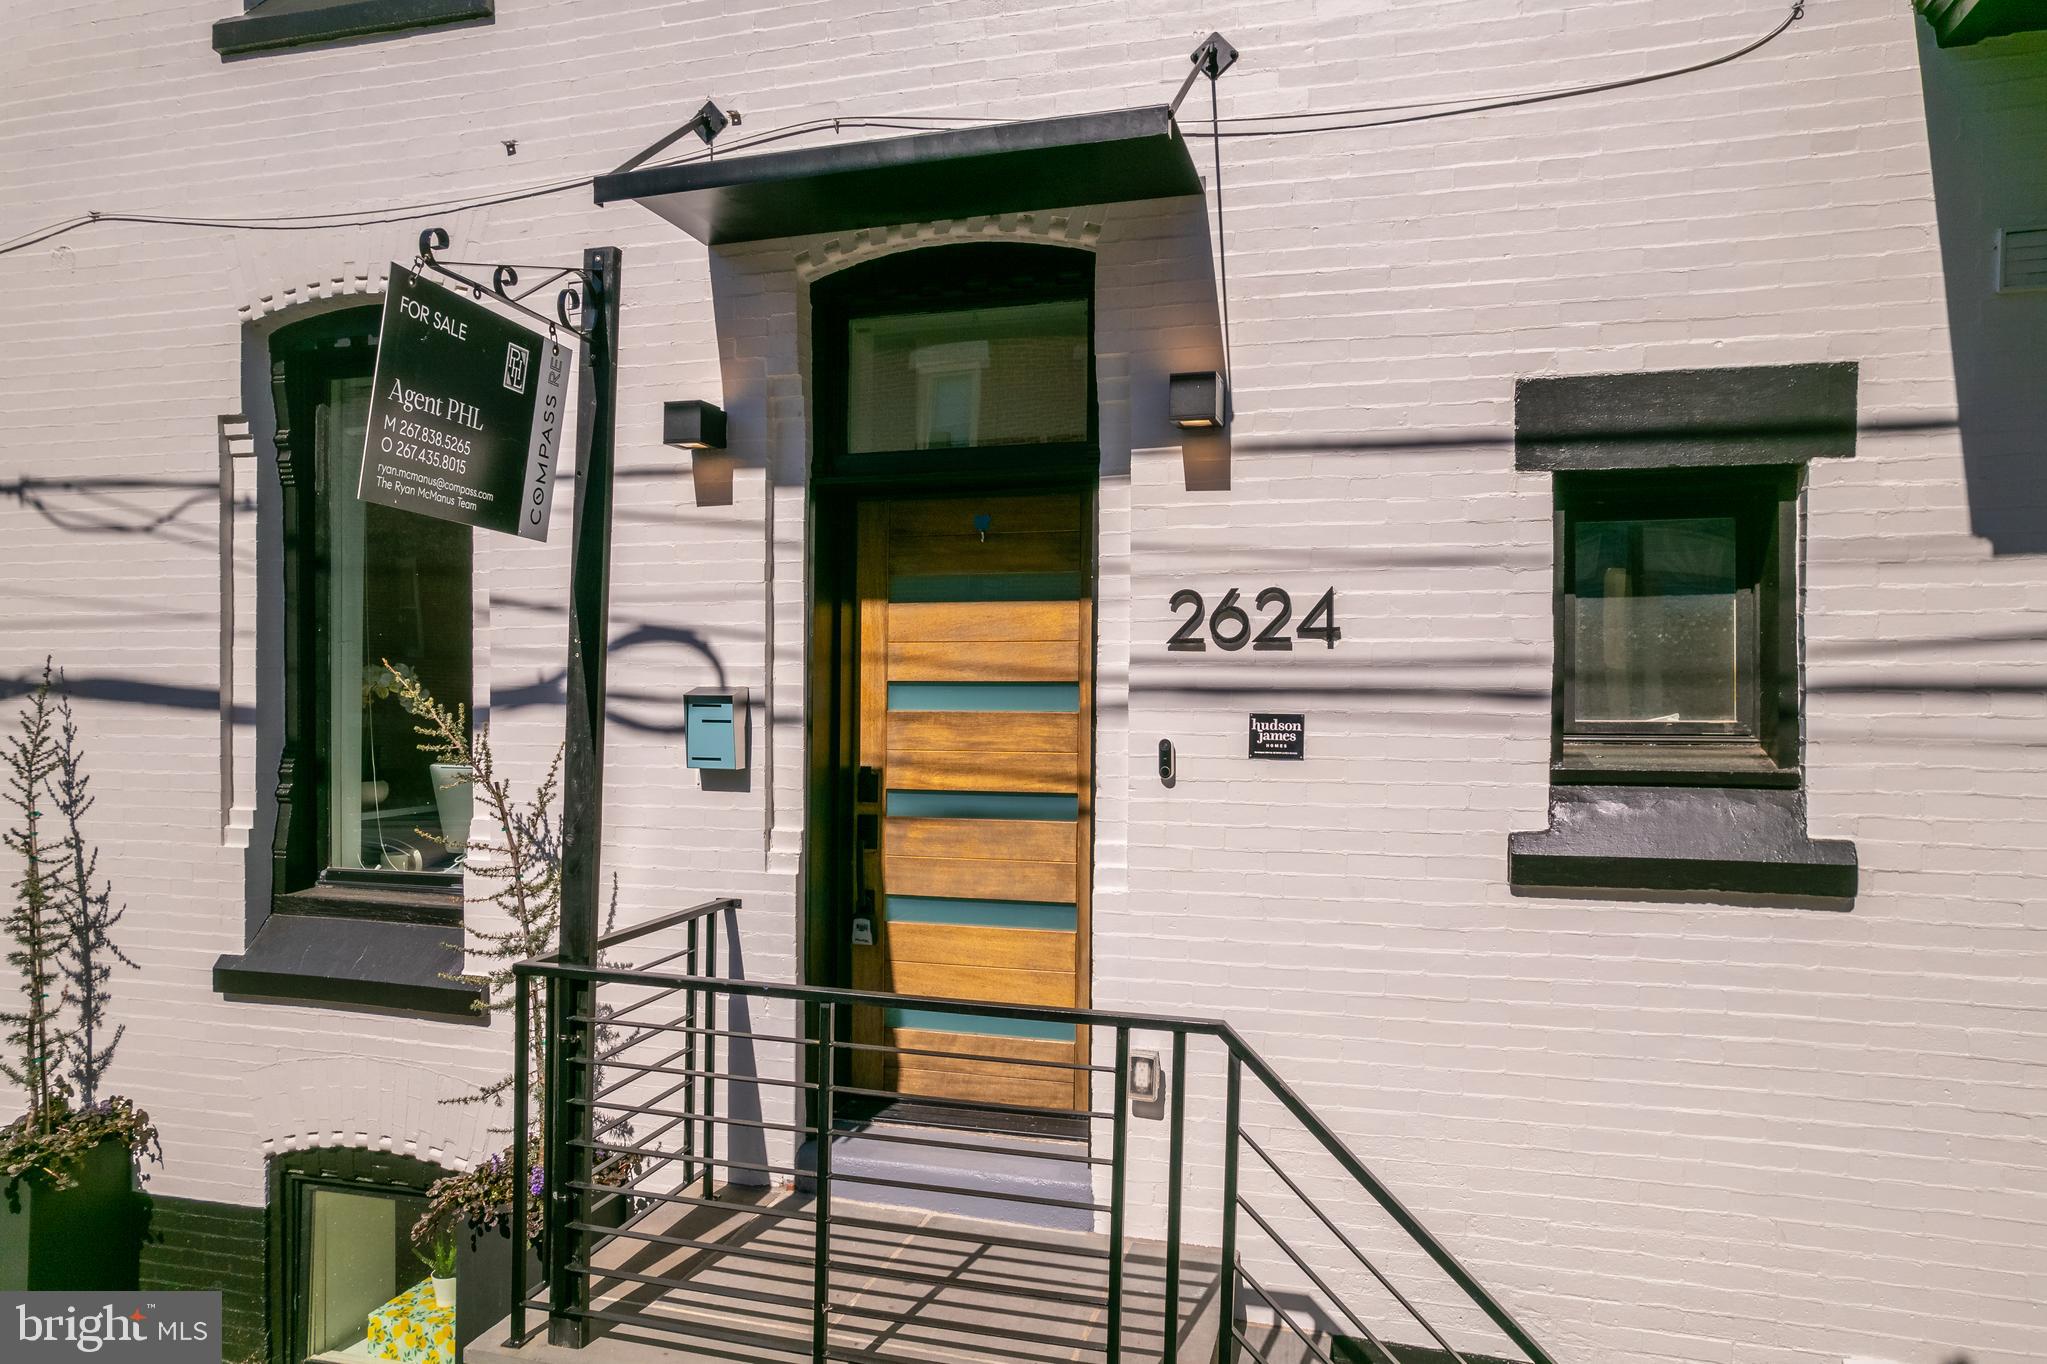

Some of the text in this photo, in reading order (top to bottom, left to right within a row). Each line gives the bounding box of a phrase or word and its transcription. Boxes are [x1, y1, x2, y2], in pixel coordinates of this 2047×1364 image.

[400, 296, 467, 341] FOR SALE
[388, 378, 484, 431] Agent PHL
[381, 436, 466, 474] O 267.435.8015
[384, 414, 471, 456] M 267.838.5265
[530, 357, 562, 525] COMPASS RE
[376, 476, 477, 511] The Ryan McManus Team
[377, 463, 494, 501] ryan.mcmanus@compass.com
[1166, 586, 1341, 652] 2624
[1251, 718, 1302, 732] hudson
[1257, 731, 1297, 744] james
